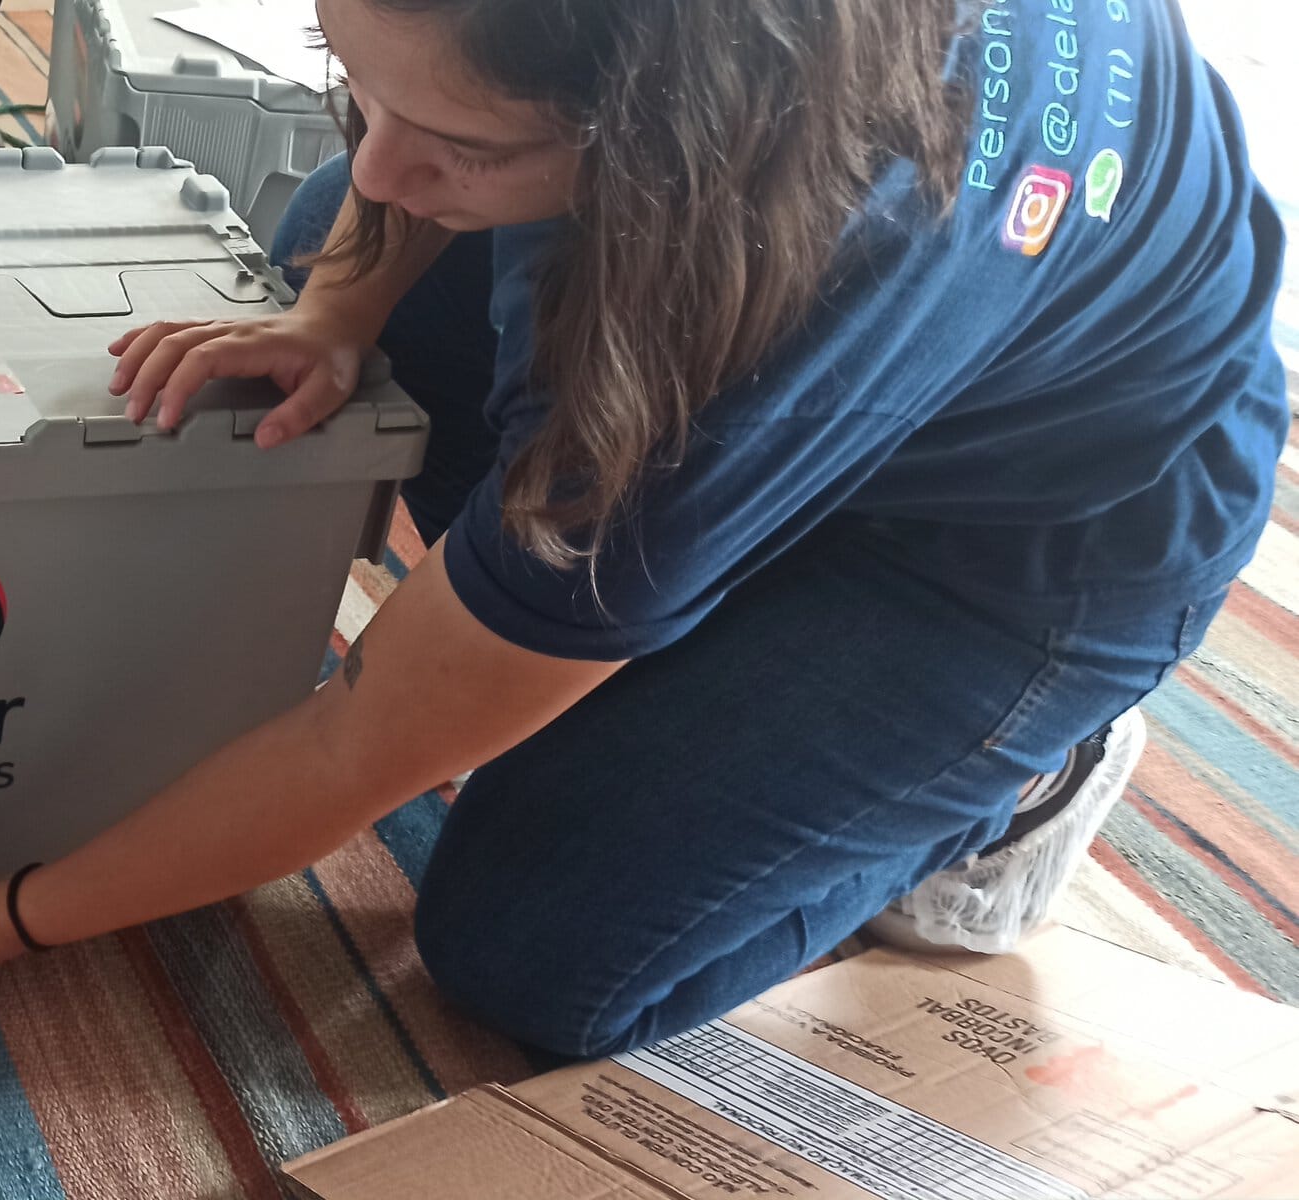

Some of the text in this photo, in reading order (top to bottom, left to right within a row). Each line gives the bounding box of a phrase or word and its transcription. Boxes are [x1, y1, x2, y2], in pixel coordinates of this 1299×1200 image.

[968, 0, 1012, 191] Person
[955, 998, 1061, 1042] BASTOS
[941, 1030, 1017, 1064] OVOS
